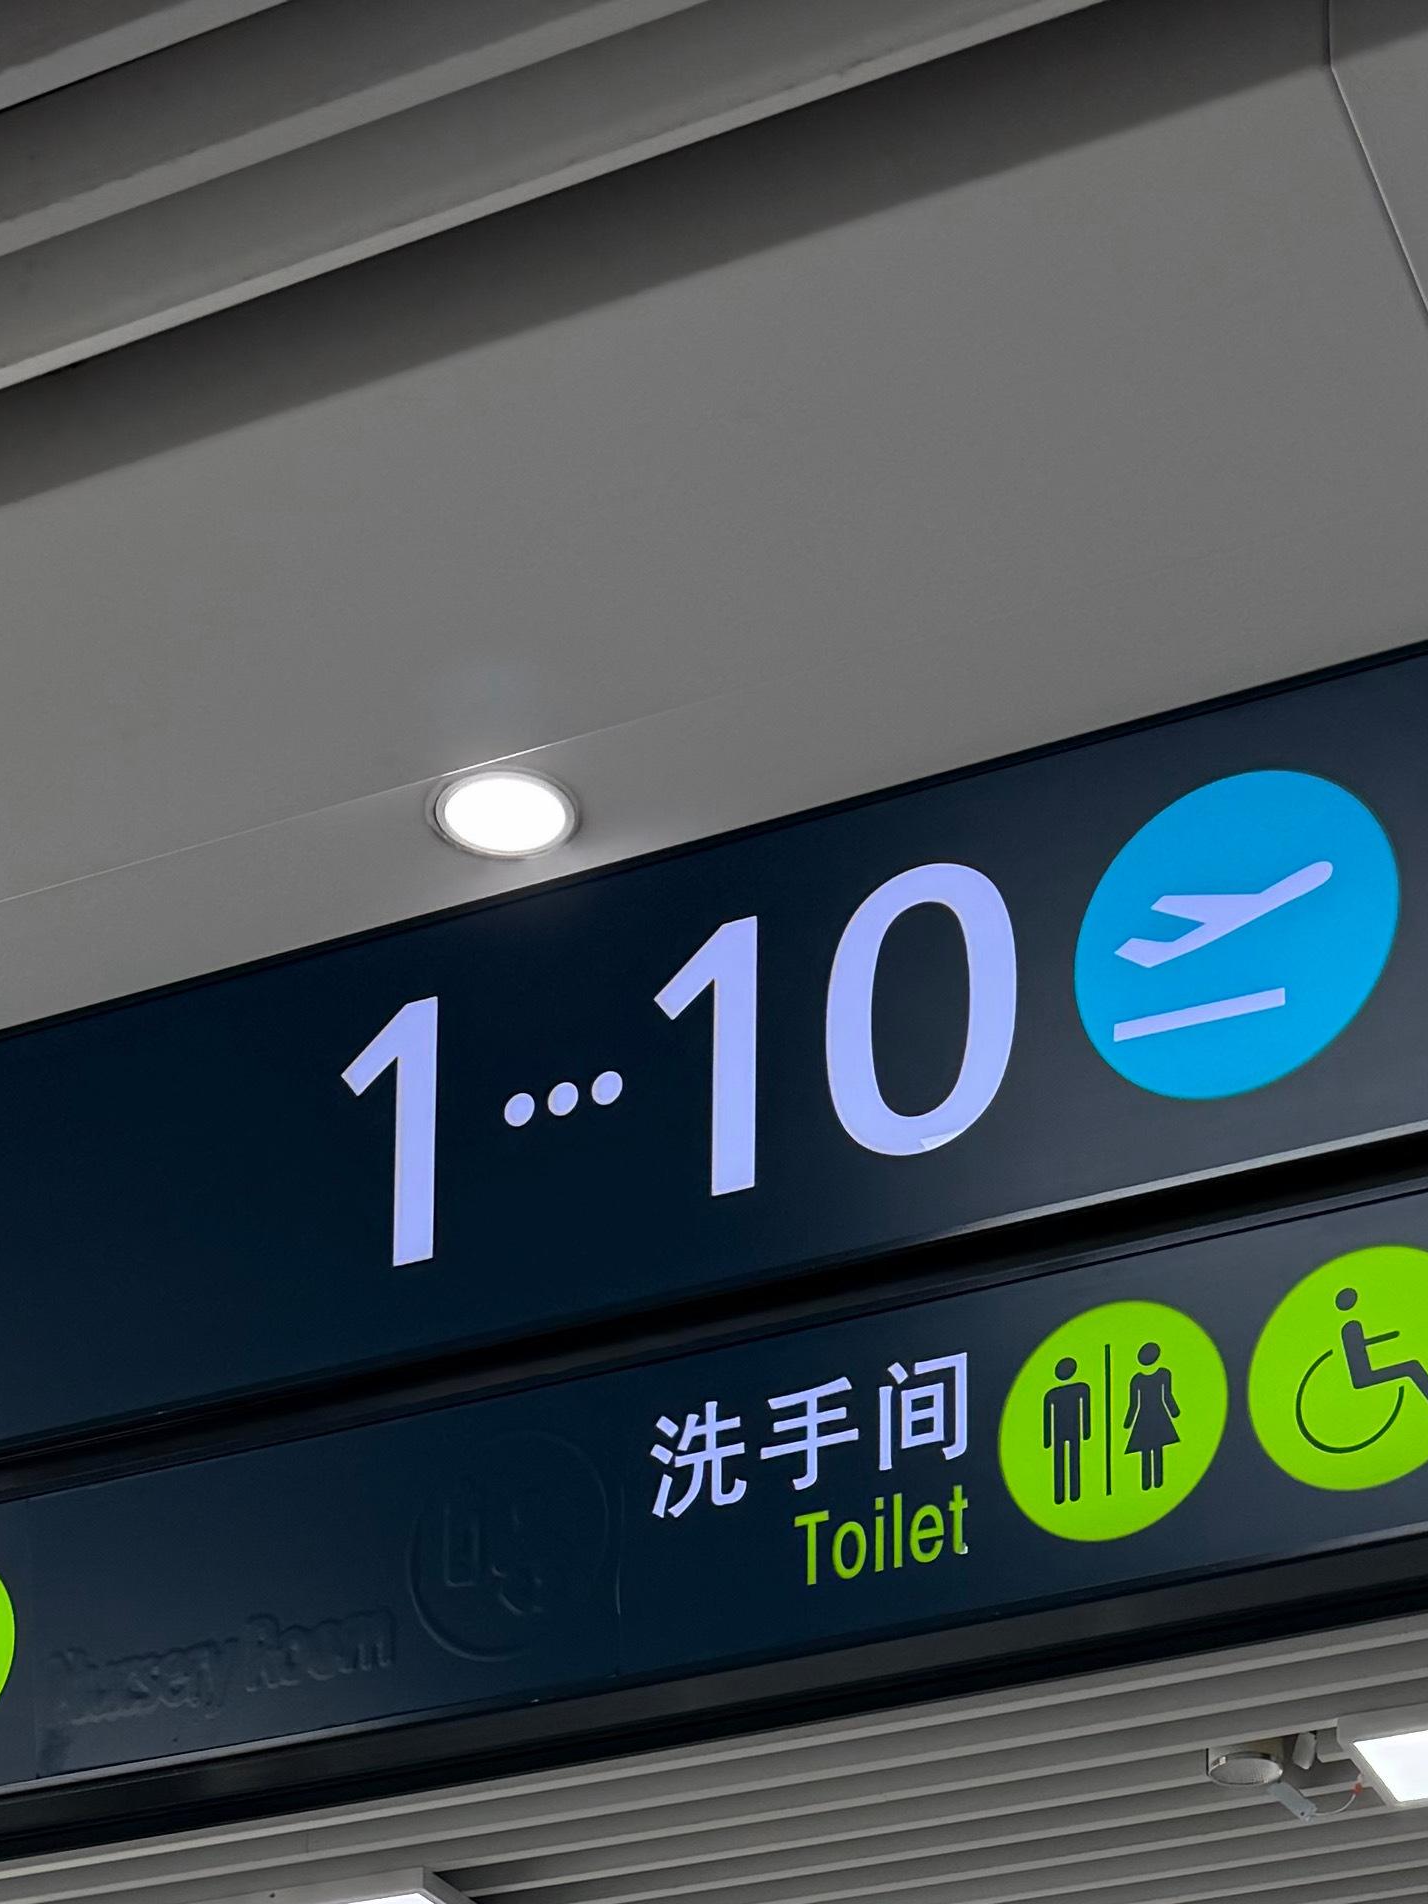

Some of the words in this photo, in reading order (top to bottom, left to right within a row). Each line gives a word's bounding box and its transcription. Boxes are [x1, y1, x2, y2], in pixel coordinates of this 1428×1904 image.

[651, 1352, 968, 1517] 洗手间
[795, 1487, 967, 1584] Toilet
